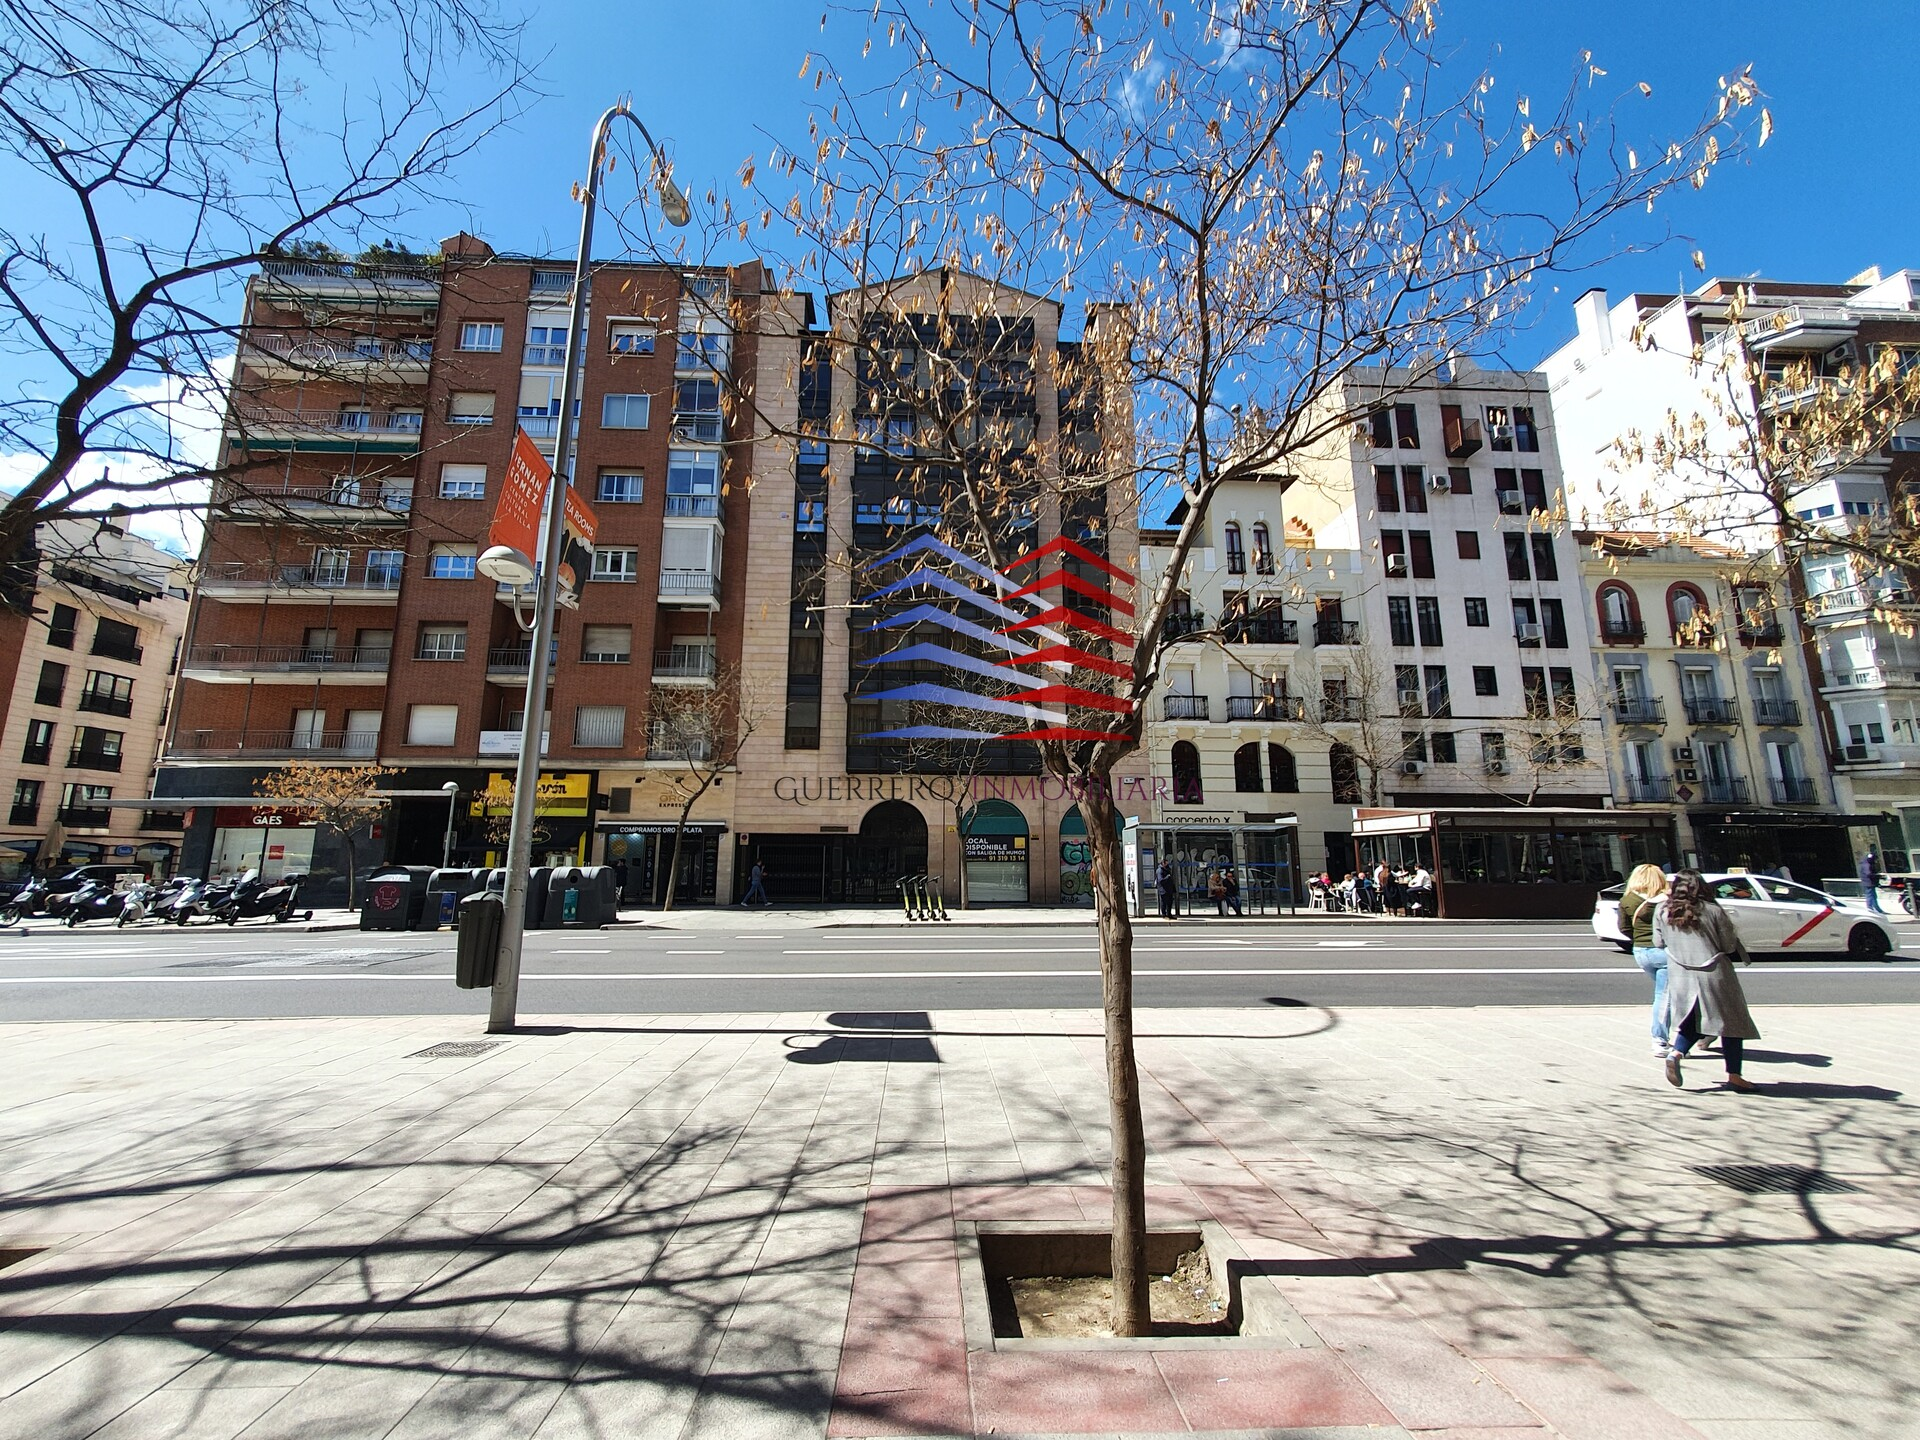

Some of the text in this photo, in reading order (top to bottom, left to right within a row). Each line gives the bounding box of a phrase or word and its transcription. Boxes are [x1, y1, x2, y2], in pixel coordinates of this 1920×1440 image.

[510, 466, 539, 505] GÓMEZ
[510, 485, 527, 508] CENTRO
[513, 511, 531, 530] VILLA
[564, 498, 594, 537] TEA ROOMS
[252, 815, 283, 825] GAES
